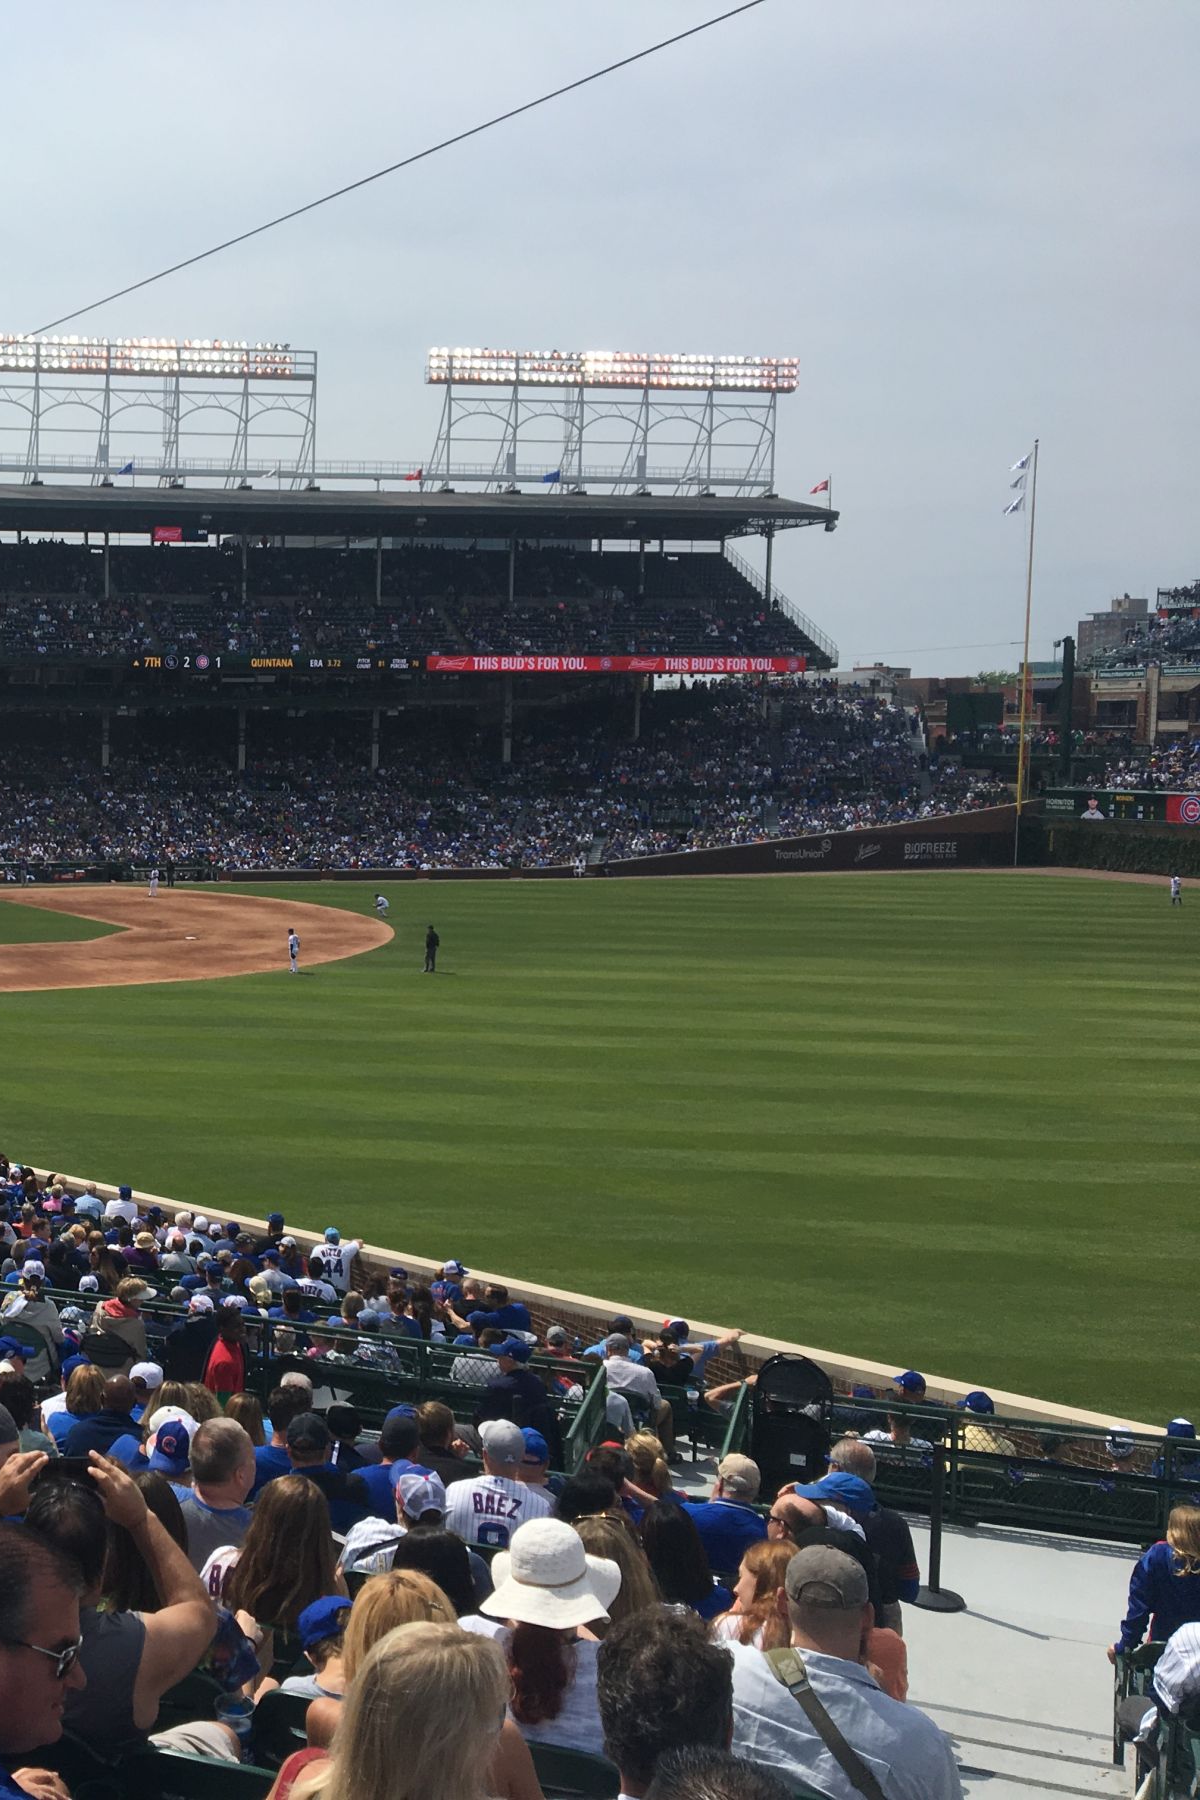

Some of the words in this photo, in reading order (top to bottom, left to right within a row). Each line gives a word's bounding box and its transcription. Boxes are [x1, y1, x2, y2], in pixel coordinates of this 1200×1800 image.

[144, 657, 161, 668] 7TH
[183, 656, 190, 668] 2
[215, 657, 221, 668] 1
[251, 658, 293, 668] QUINTANA
[309, 659, 323, 668] ERA
[327, 660, 341, 668] 3.72
[473, 657, 499, 670] THIS
[501, 657, 535, 670] BUD'S
[538, 657, 560, 670] FOR
[562, 657, 588, 670] YOU.
[664, 658, 689, 670] THIS
[691, 658, 725, 671] BUD'S
[727, 658, 748, 671] FOR
[751, 658, 775, 671] YOU.
[775, 849, 824, 860] TransUnion
[321, 1248, 342, 1259] RIZZO
[323, 1260, 344, 1278] 44
[473, 1492, 522, 1520] BAEZ
